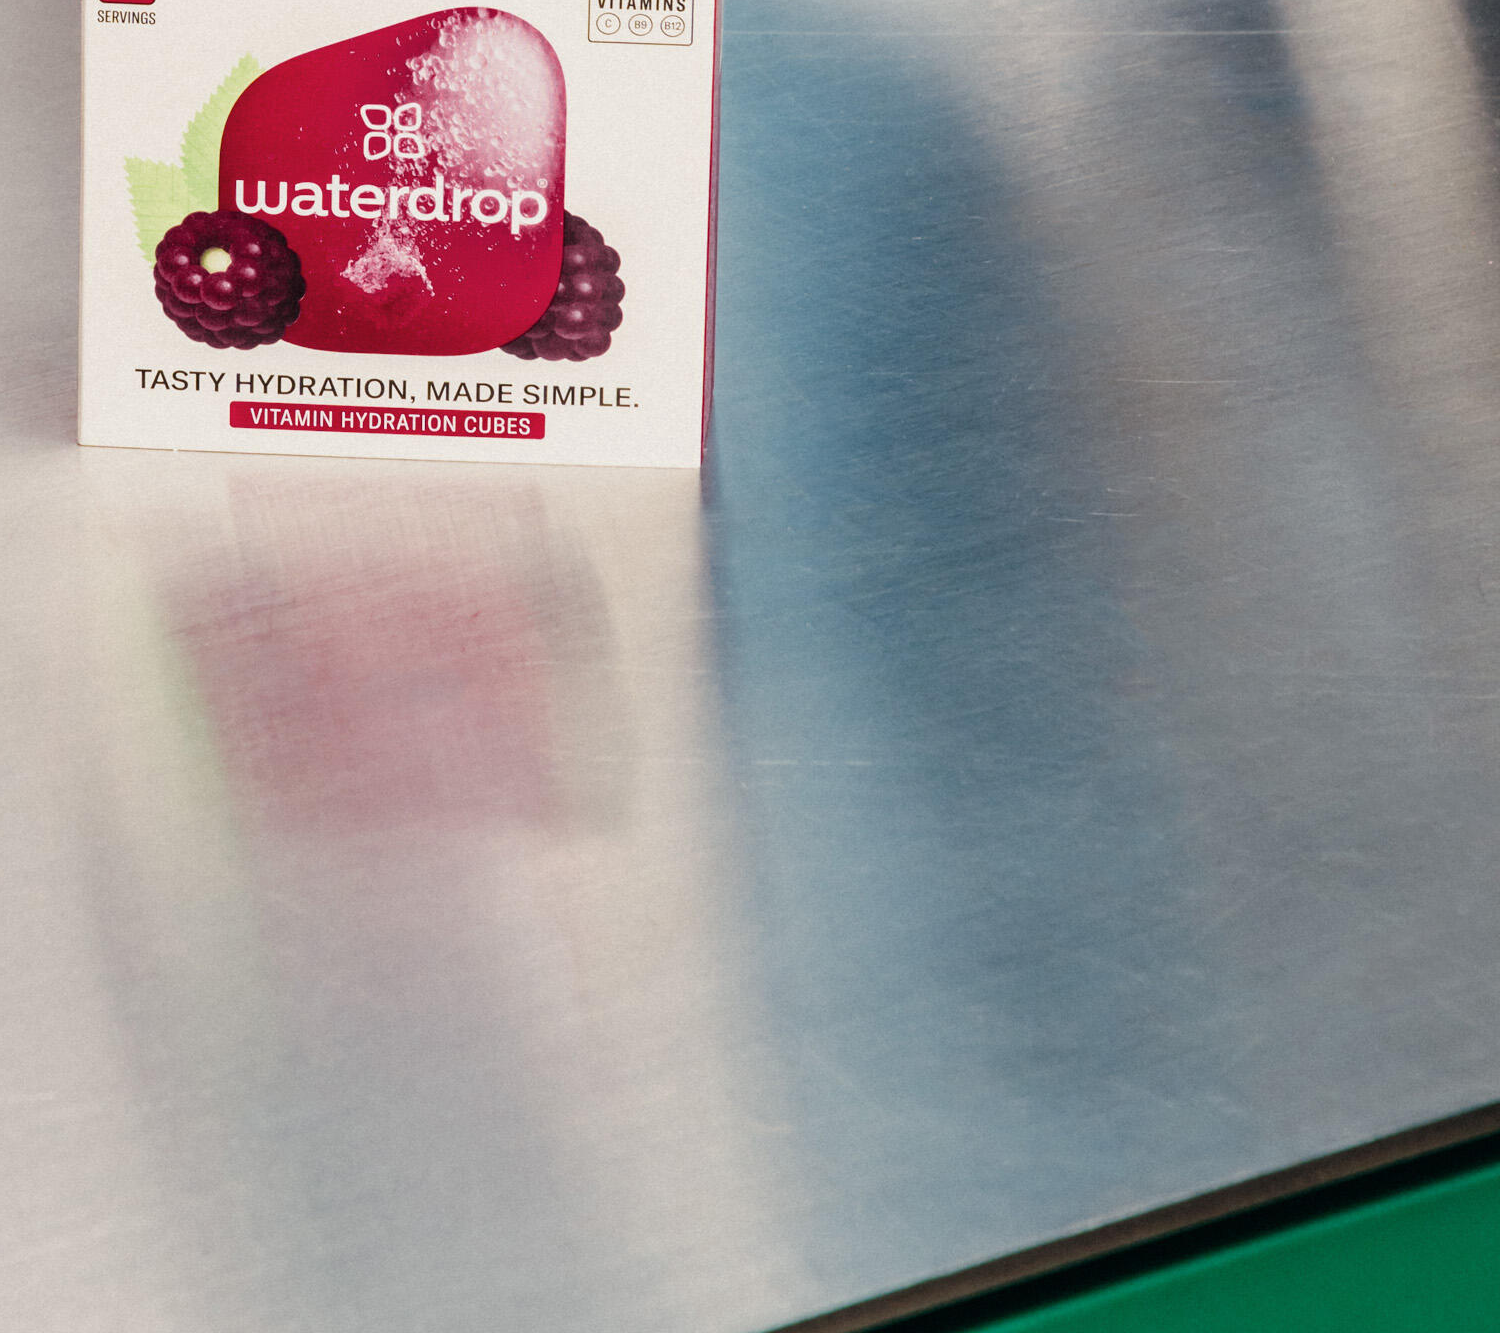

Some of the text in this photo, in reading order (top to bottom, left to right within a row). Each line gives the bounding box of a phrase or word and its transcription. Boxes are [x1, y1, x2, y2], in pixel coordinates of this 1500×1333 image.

[97, 9, 156, 25] SERVINGS
[604, 18, 682, 31] C B9 B12
[134, 368, 639, 408] TASTY HYDRATION, MADE SIMPLE.
[250, 407, 531, 435] VITAMIN HYDRATION CUBES
